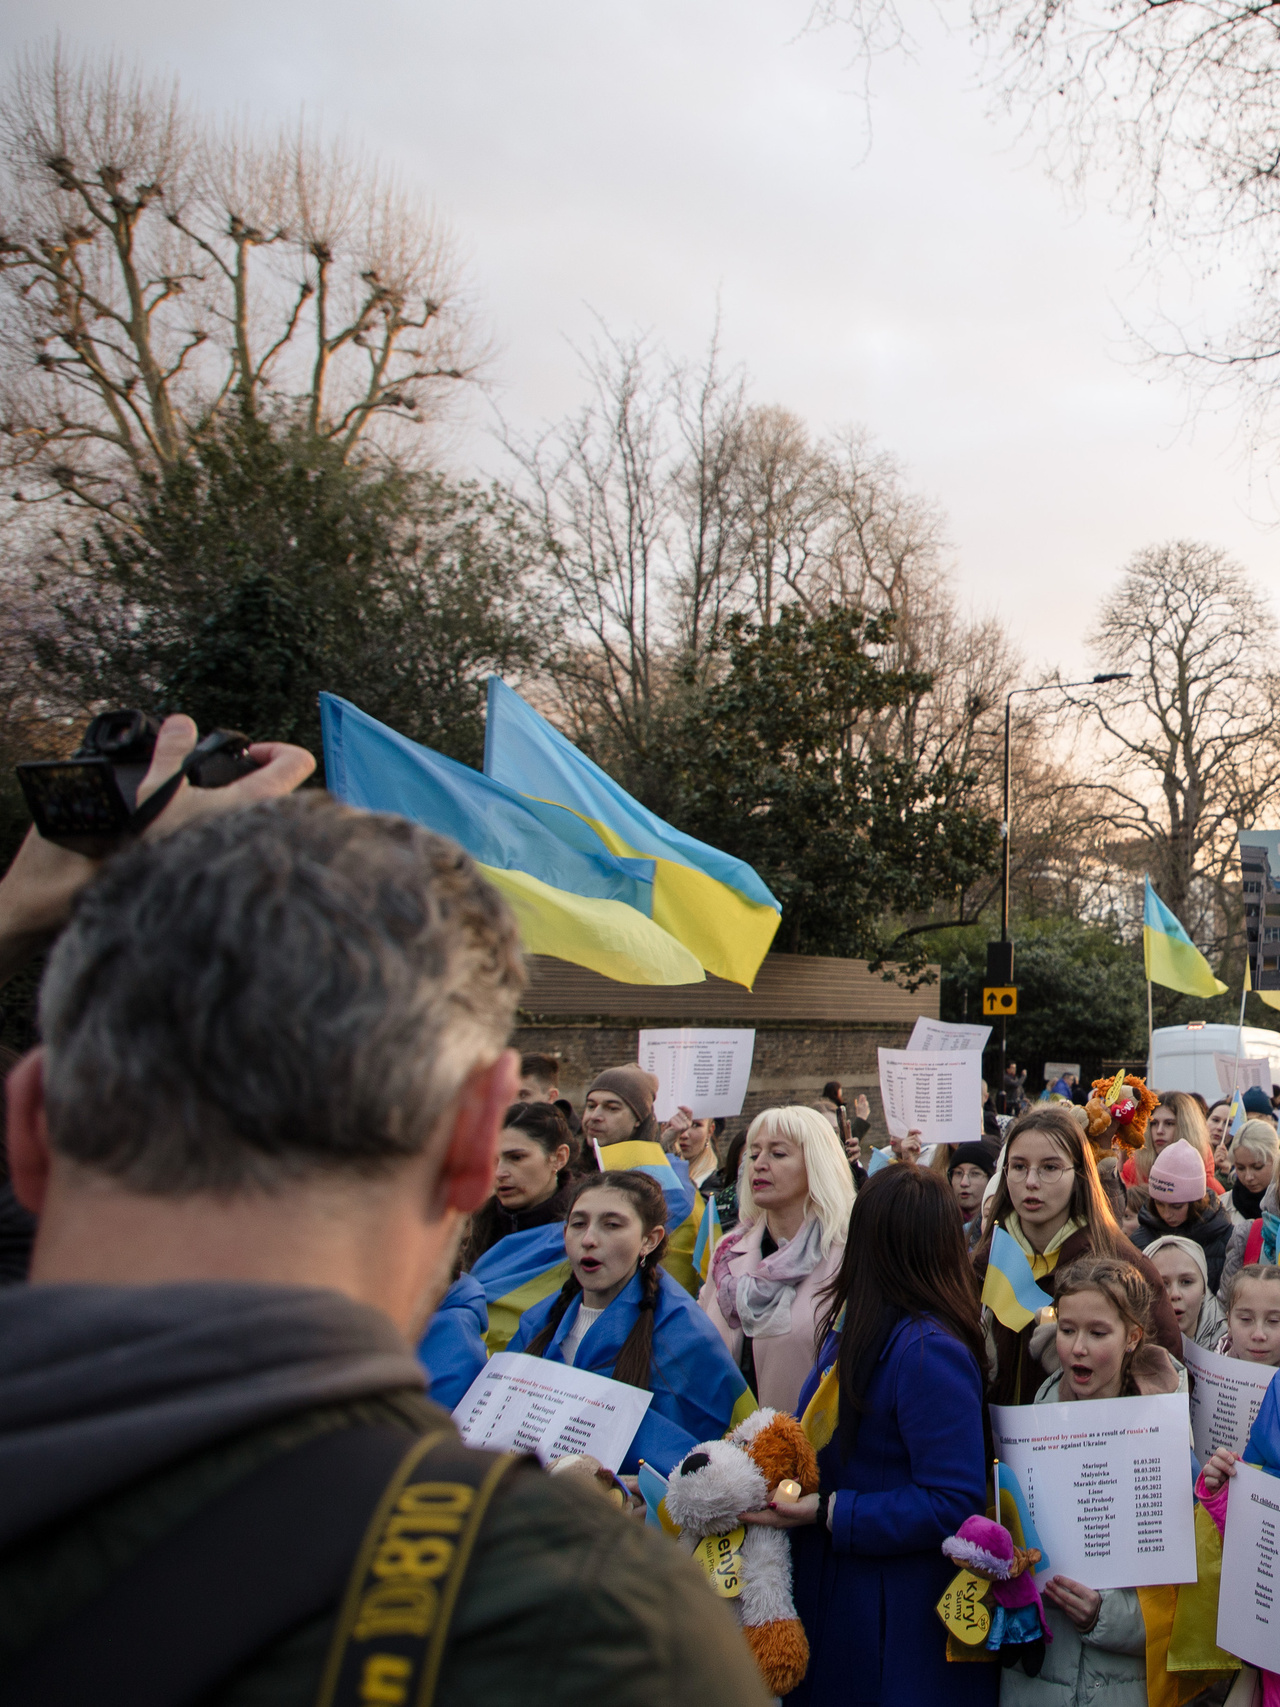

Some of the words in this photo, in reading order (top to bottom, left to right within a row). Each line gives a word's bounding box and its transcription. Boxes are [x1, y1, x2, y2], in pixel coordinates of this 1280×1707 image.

[1115, 1101, 1134, 1116] LOVE
[532, 1403, 556, 1415] Mariupol
[527, 1412, 551, 1424] Mariupol
[570, 1416, 595, 1428] unknown
[522, 1421, 546, 1433] Mariupol
[564, 1425, 591, 1438] unknown
[517, 1430, 541, 1442] Mariupol
[560, 1434, 586, 1447] unknown
[1061, 1441, 1081, 1450] against
[1084, 1532, 1110, 1540] Mariupol
[1085, 1541, 1110, 1549] Mariupol
[717, 1532, 737, 1589] enys
[954, 1590, 963, 1621] Sumy
[963, 1581, 978, 1630] Kyryl
